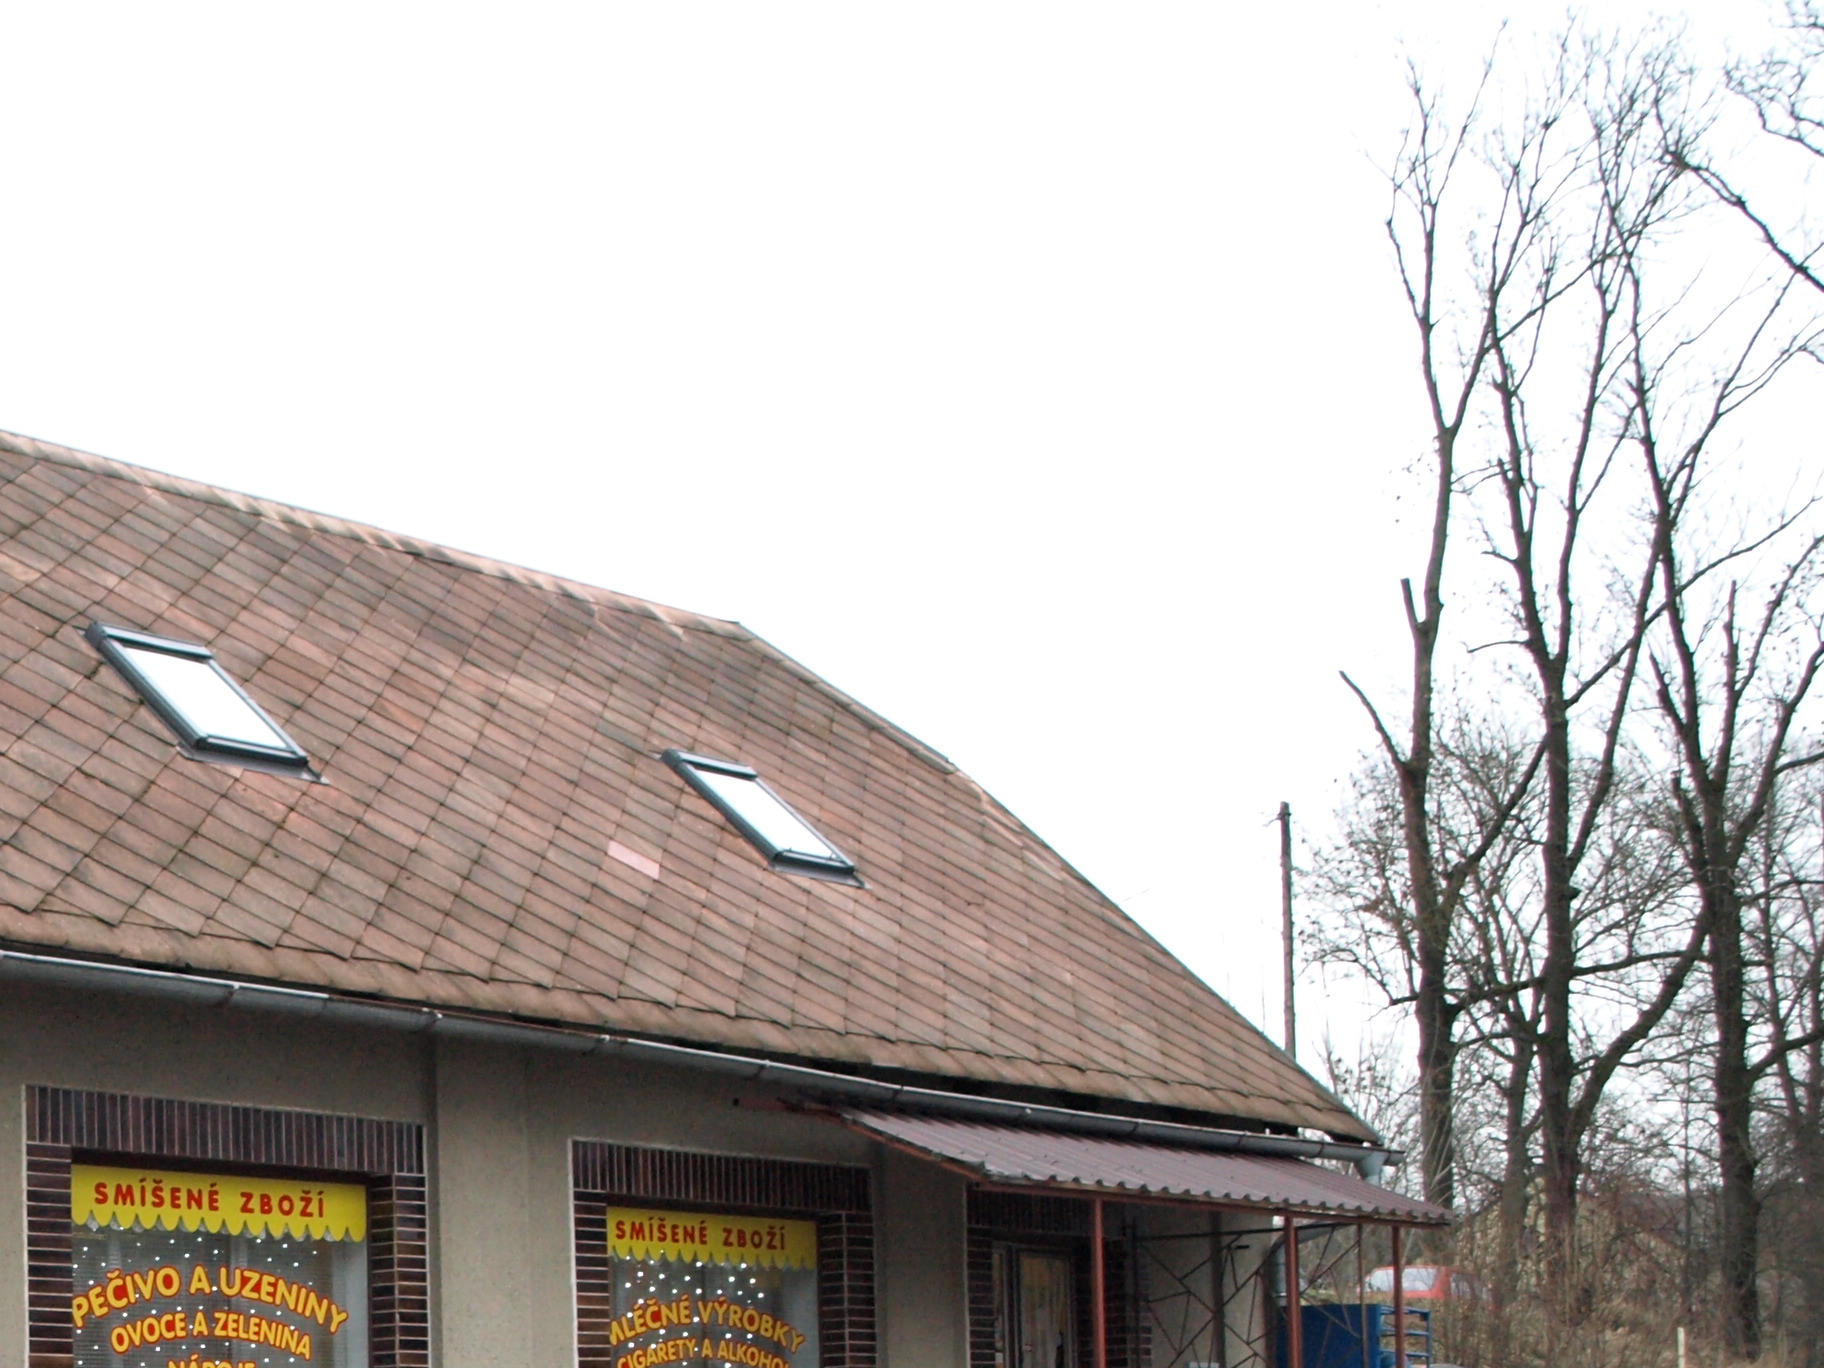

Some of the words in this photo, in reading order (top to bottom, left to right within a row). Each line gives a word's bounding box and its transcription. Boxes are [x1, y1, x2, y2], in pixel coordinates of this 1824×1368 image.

[94, 1177, 220, 1212] SMÍŠENÉ
[240, 1189, 325, 1218] ZBOŽÍ
[615, 1216, 708, 1246] SMÍŠENÉ
[722, 1225, 786, 1250] ZBOŽÍ
[71, 1265, 182, 1329] PEČIVO
[188, 1264, 212, 1295] A
[218, 1265, 349, 1334] UZENINY
[110, 1311, 188, 1355] OVOCE
[191, 1310, 209, 1337] A
[212, 1310, 312, 1361] ZELENINA
[697, 1295, 806, 1354] VÝROBKY
[700, 1337, 714, 1359] A
